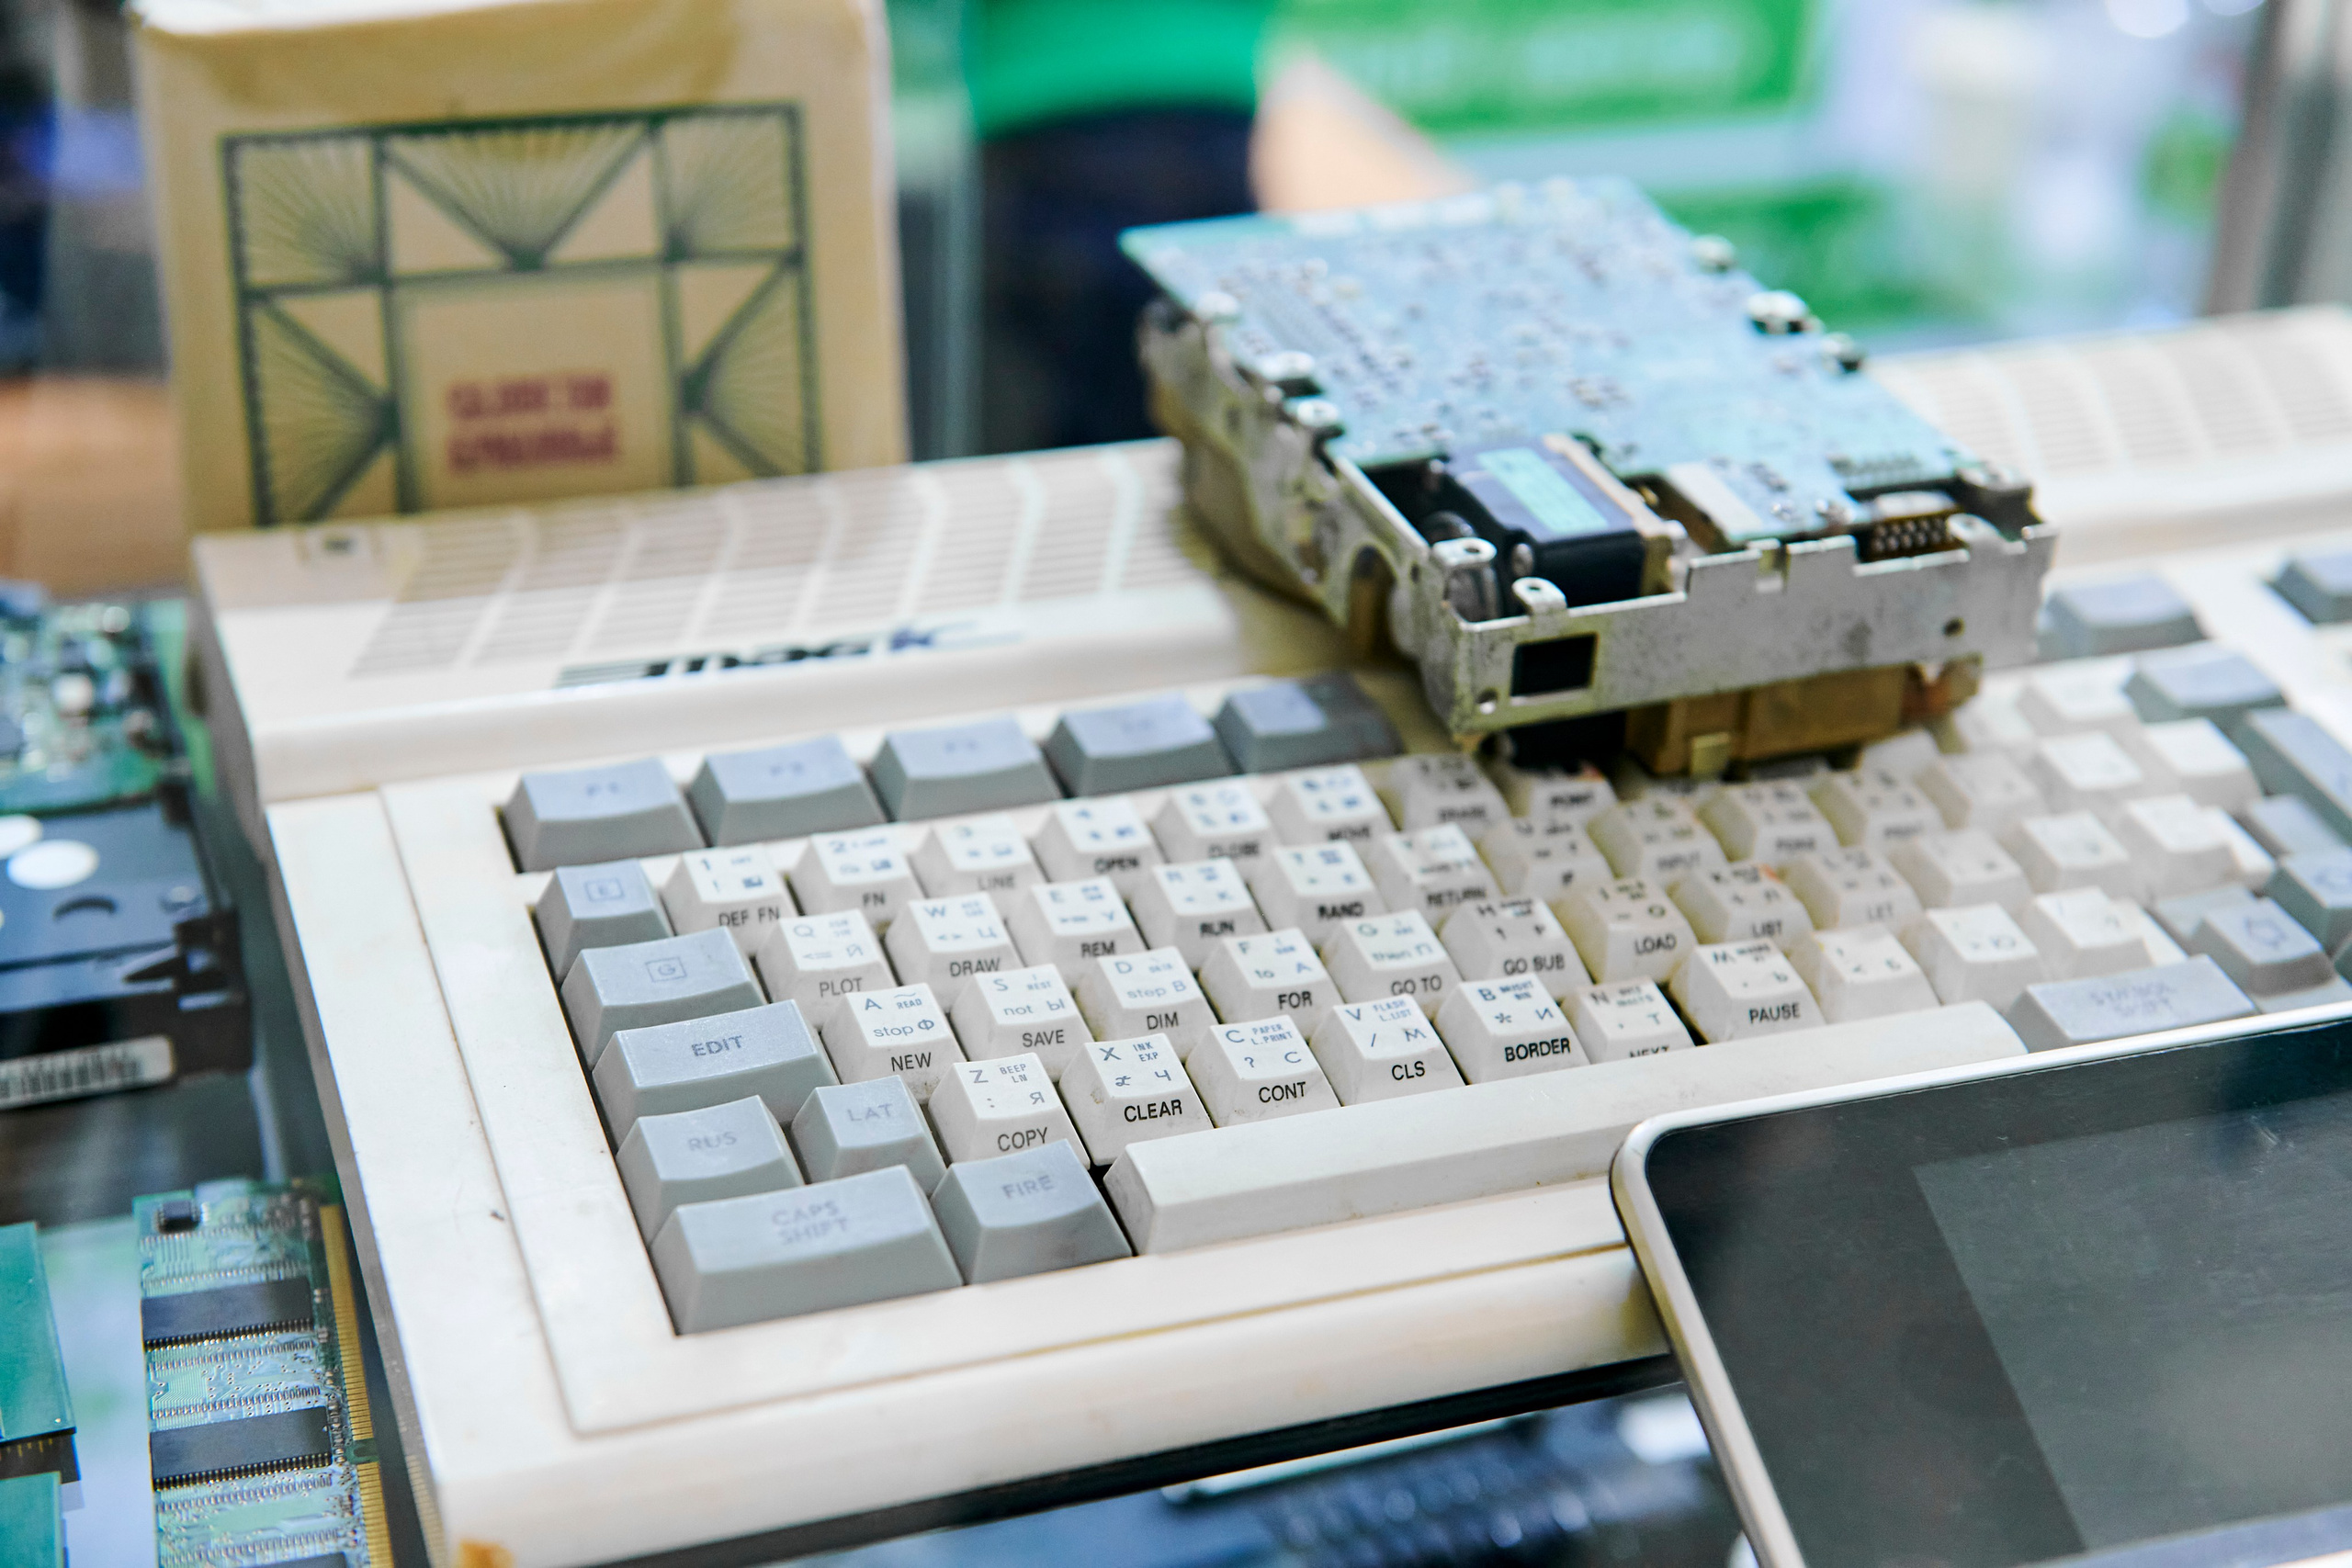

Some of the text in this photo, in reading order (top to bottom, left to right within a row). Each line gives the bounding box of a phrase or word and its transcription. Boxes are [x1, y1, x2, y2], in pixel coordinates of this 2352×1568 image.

[701, 858, 712, 871] 1
[1094, 855, 1139, 873] OPEN
[976, 876, 1014, 891] LINE
[863, 891, 885, 908] FN
[718, 906, 779, 927] DEF FN
[922, 905, 945, 918] W
[793, 924, 815, 938] Q
[1200, 922, 1235, 938] RUN
[1752, 919, 1782, 937] LIST
[1081, 940, 1115, 958] REM
[1634, 932, 1677, 954] LOAD
[949, 958, 1001, 978] DRAW
[1114, 961, 1133, 975] D
[1504, 953, 1565, 976] GO SUB
[1255, 969, 1274, 979] to
[820, 977, 865, 998] PLOT
[993, 978, 1010, 992] S
[1391, 975, 1442, 996] GO TO
[1278, 990, 1313, 1010] FOR
[1477, 987, 1497, 1001] B
[865, 998, 922, 1010] A READ
[1003, 1005, 1035, 1016] not
[1374, 999, 1407, 1012] FLASH
[1147, 1011, 1179, 1031] DIM
[1345, 1008, 1362, 1021] V
[1749, 1002, 1801, 1024] PAUSE
[874, 1024, 914, 1037] stop
[917, 1019, 935, 1031] Ф
[1251, 1023, 1283, 1035] PAPER
[1022, 1029, 1066, 1048] SAVE
[1226, 1030, 1245, 1043] C
[1250, 1031, 1293, 1045] L.PRINT
[691, 1035, 742, 1057] EDIT
[1099, 1046, 1122, 1062] X
[1132, 1041, 1154, 1052] INK
[1504, 1038, 1571, 1062] BORDER
[891, 1052, 932, 1072] NEW
[1138, 1051, 1159, 1063] EXP
[1244, 1056, 1255, 1068] ?
[969, 1069, 989, 1084] Z
[999, 1063, 1027, 1076] BEEP
[1391, 1060, 1426, 1081] CLS
[1012, 1074, 1028, 1084] LN
[1029, 1090, 1046, 1105] Я
[1259, 1081, 1306, 1103] CONT
[846, 1102, 895, 1122] LAT
[1124, 1099, 1183, 1122] CLEAR
[687, 1130, 737, 1152] RUS
[997, 1126, 1048, 1152] COPY
[1001, 1174, 1056, 1198] FIRE
[772, 1200, 840, 1226] CAPS
[779, 1215, 848, 1245] SHIFT
